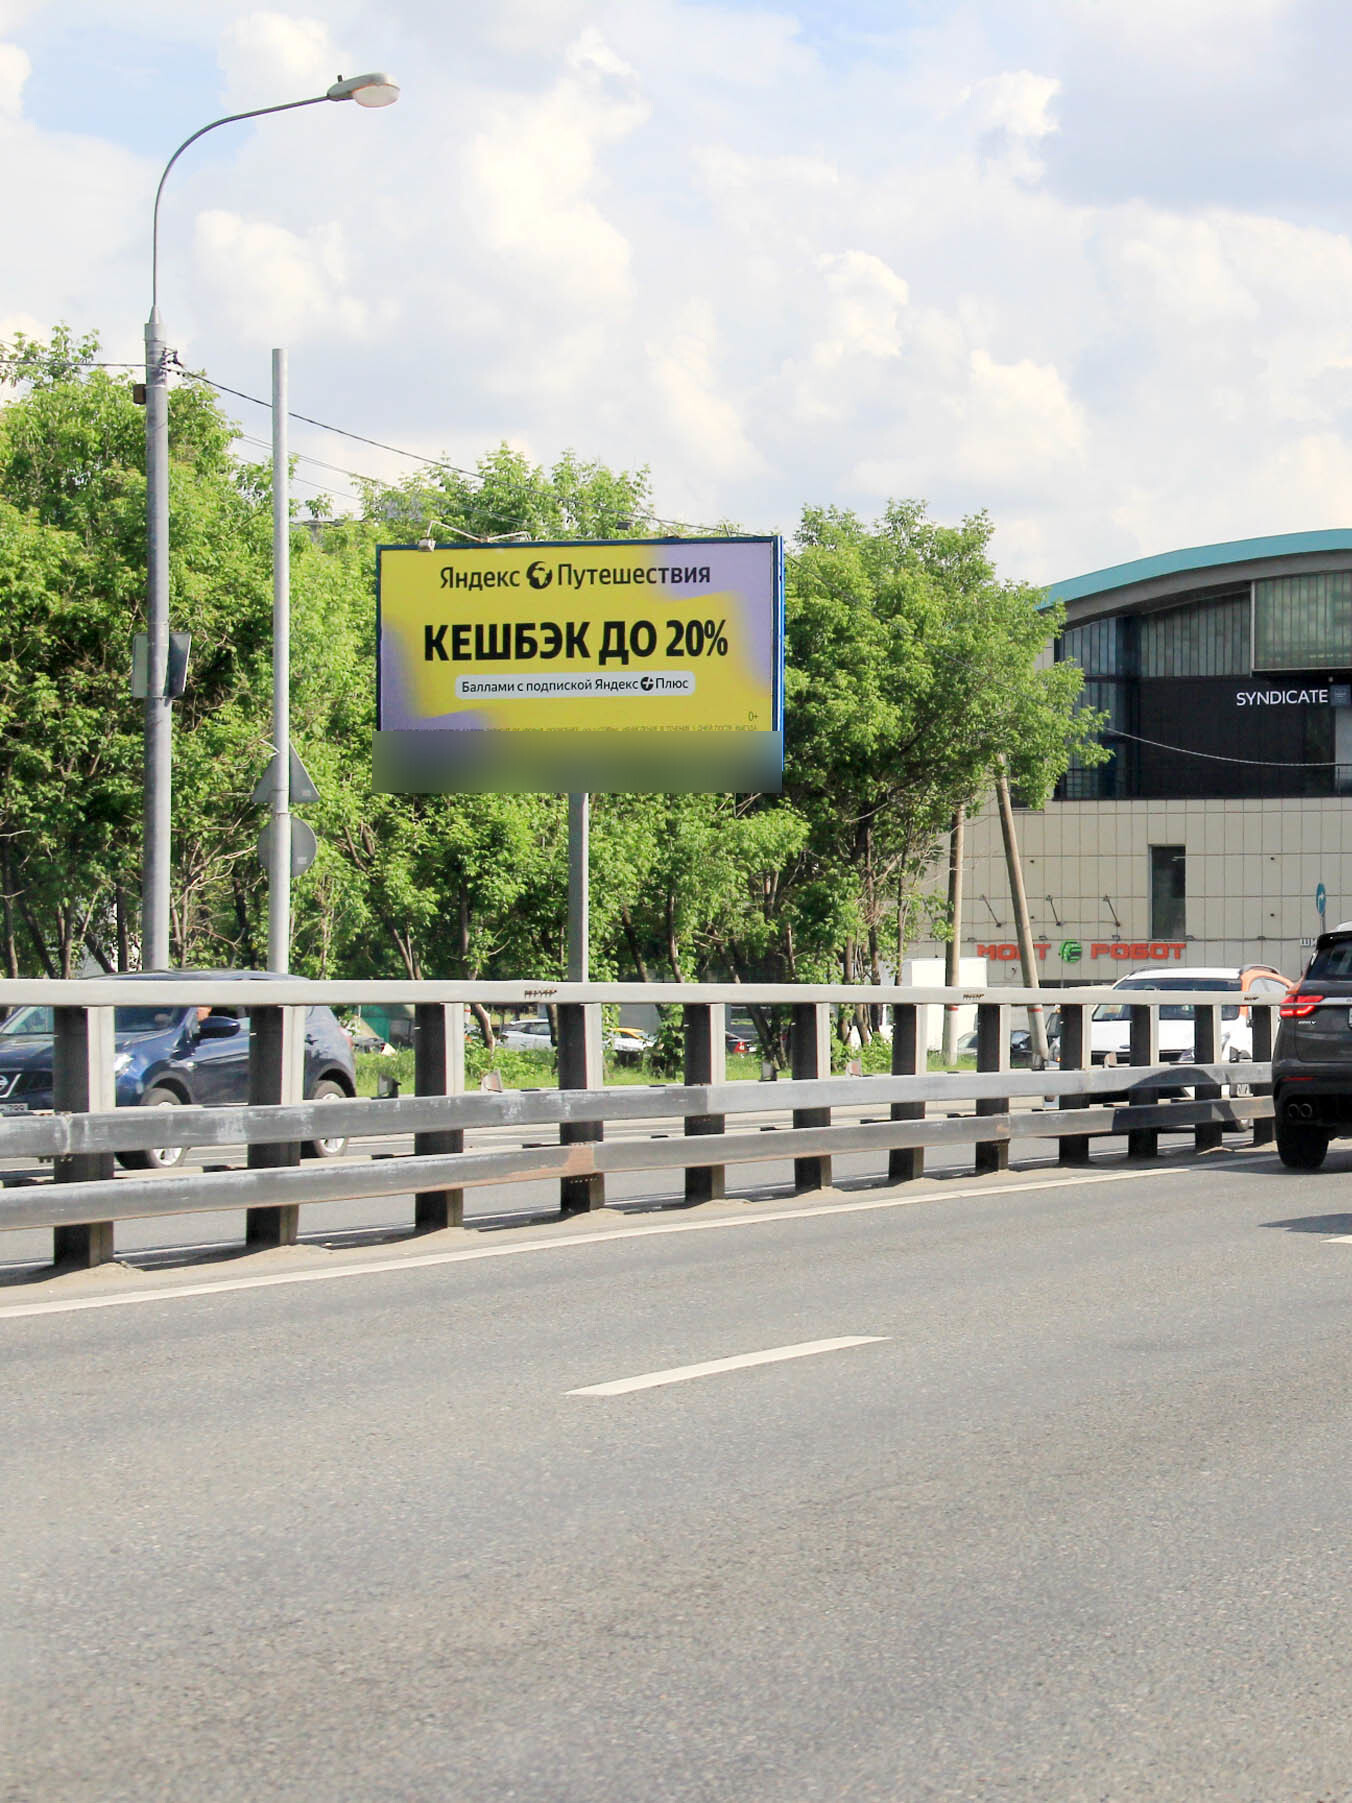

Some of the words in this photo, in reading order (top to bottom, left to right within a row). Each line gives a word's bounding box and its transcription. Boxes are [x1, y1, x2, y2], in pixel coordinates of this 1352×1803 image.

[440, 566, 520, 591] Яндекс
[558, 563, 711, 589] Путешествия
[425, 621, 591, 661] КЕШБЭК
[598, 619, 657, 665] ДО
[665, 619, 729, 657] 20%
[462, 680, 515, 693] Баллами
[517, 683, 523, 692] с
[526, 680, 593, 693] подпиской
[595, 678, 639, 691] Яндекс
[655, 677, 689, 690] Плюс
[1236, 689, 1328, 706] SYNDICATE
[1090, 943, 1187, 960] РОБОТ
